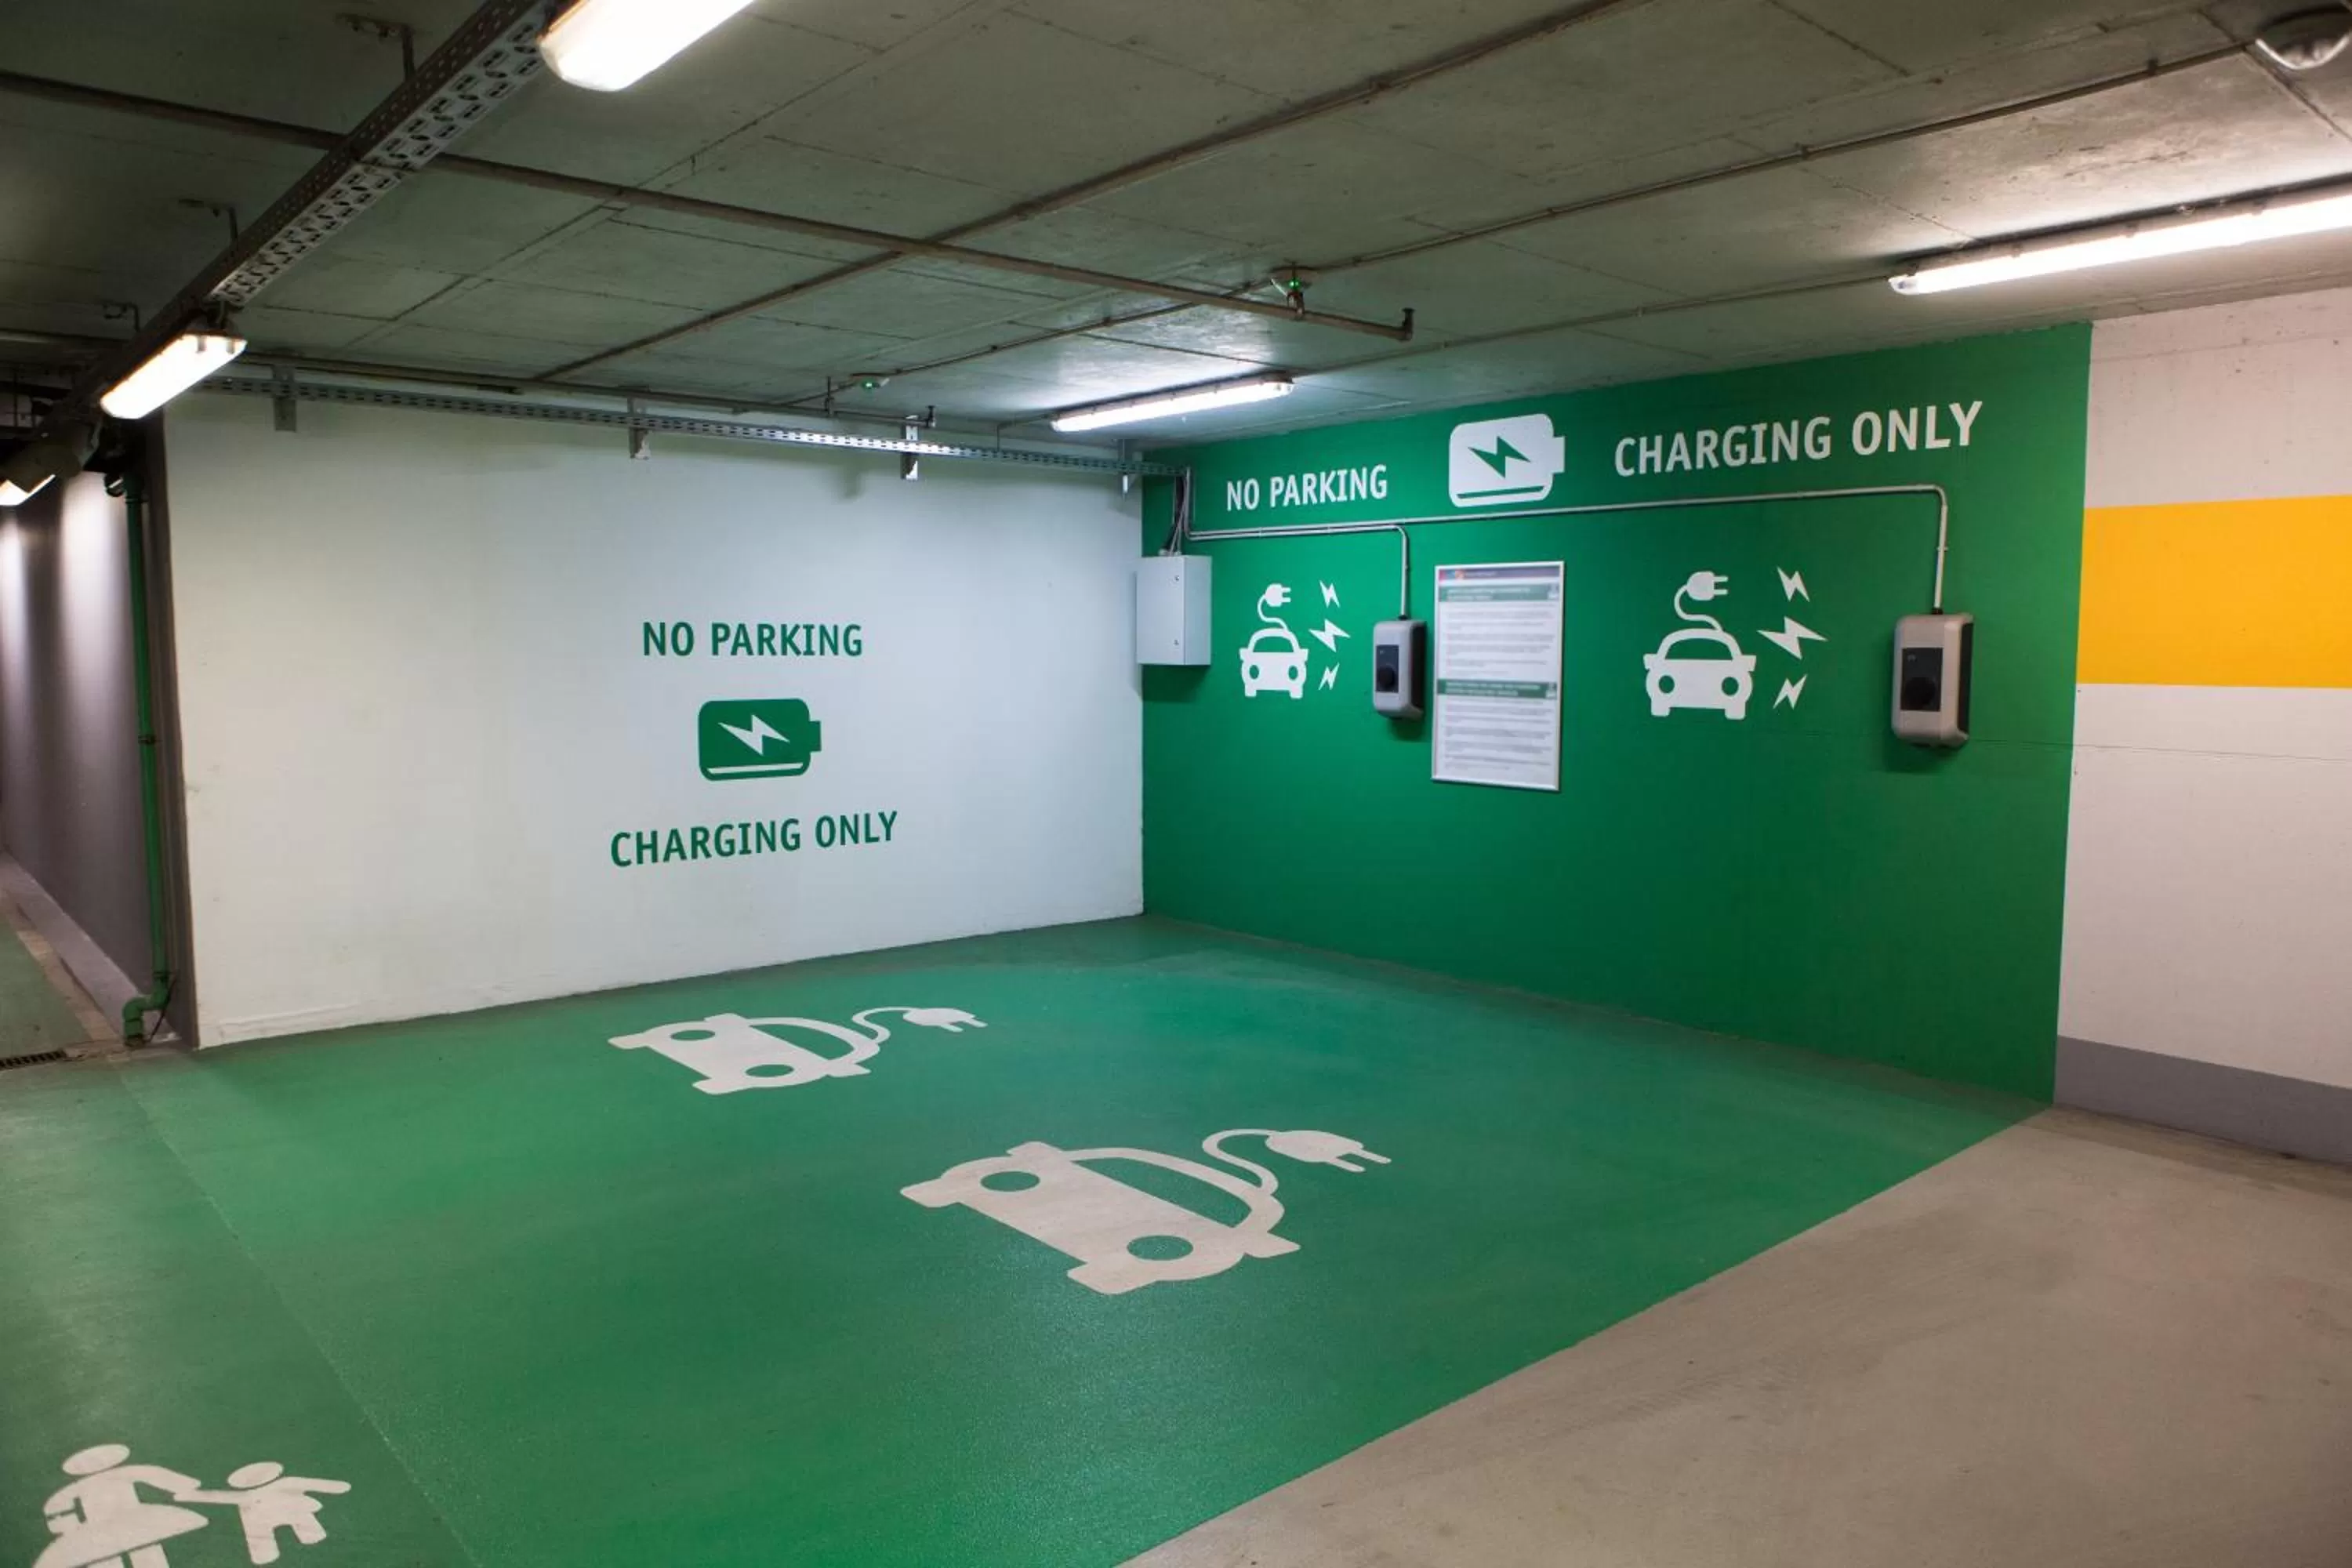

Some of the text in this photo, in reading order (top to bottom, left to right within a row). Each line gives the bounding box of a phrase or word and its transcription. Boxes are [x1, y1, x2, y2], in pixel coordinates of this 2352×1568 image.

[1615, 401, 1983, 477] CHARGING ONLY
[1227, 464, 1388, 511] NO PARKING
[642, 622, 862, 656] NO PARKING
[611, 811, 898, 867] CHARGING ONLY
